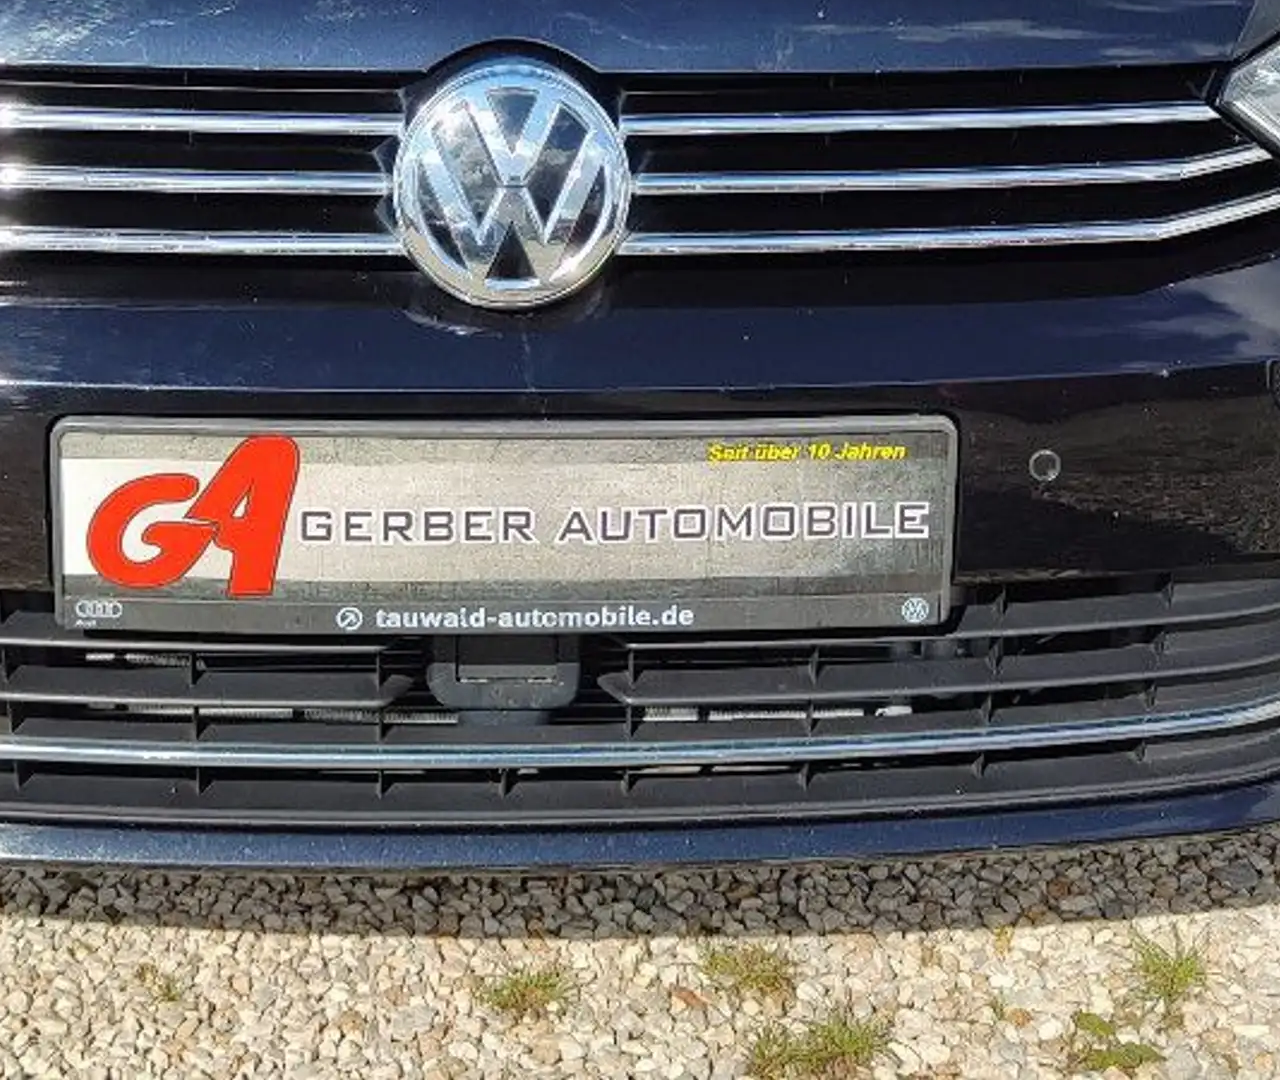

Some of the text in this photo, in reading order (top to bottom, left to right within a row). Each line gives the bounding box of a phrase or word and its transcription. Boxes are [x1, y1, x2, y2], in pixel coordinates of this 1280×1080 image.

[709, 442, 907, 462] Seit über 10 Jahren
[299, 502, 930, 544] GERBER AUTOMOBILE
